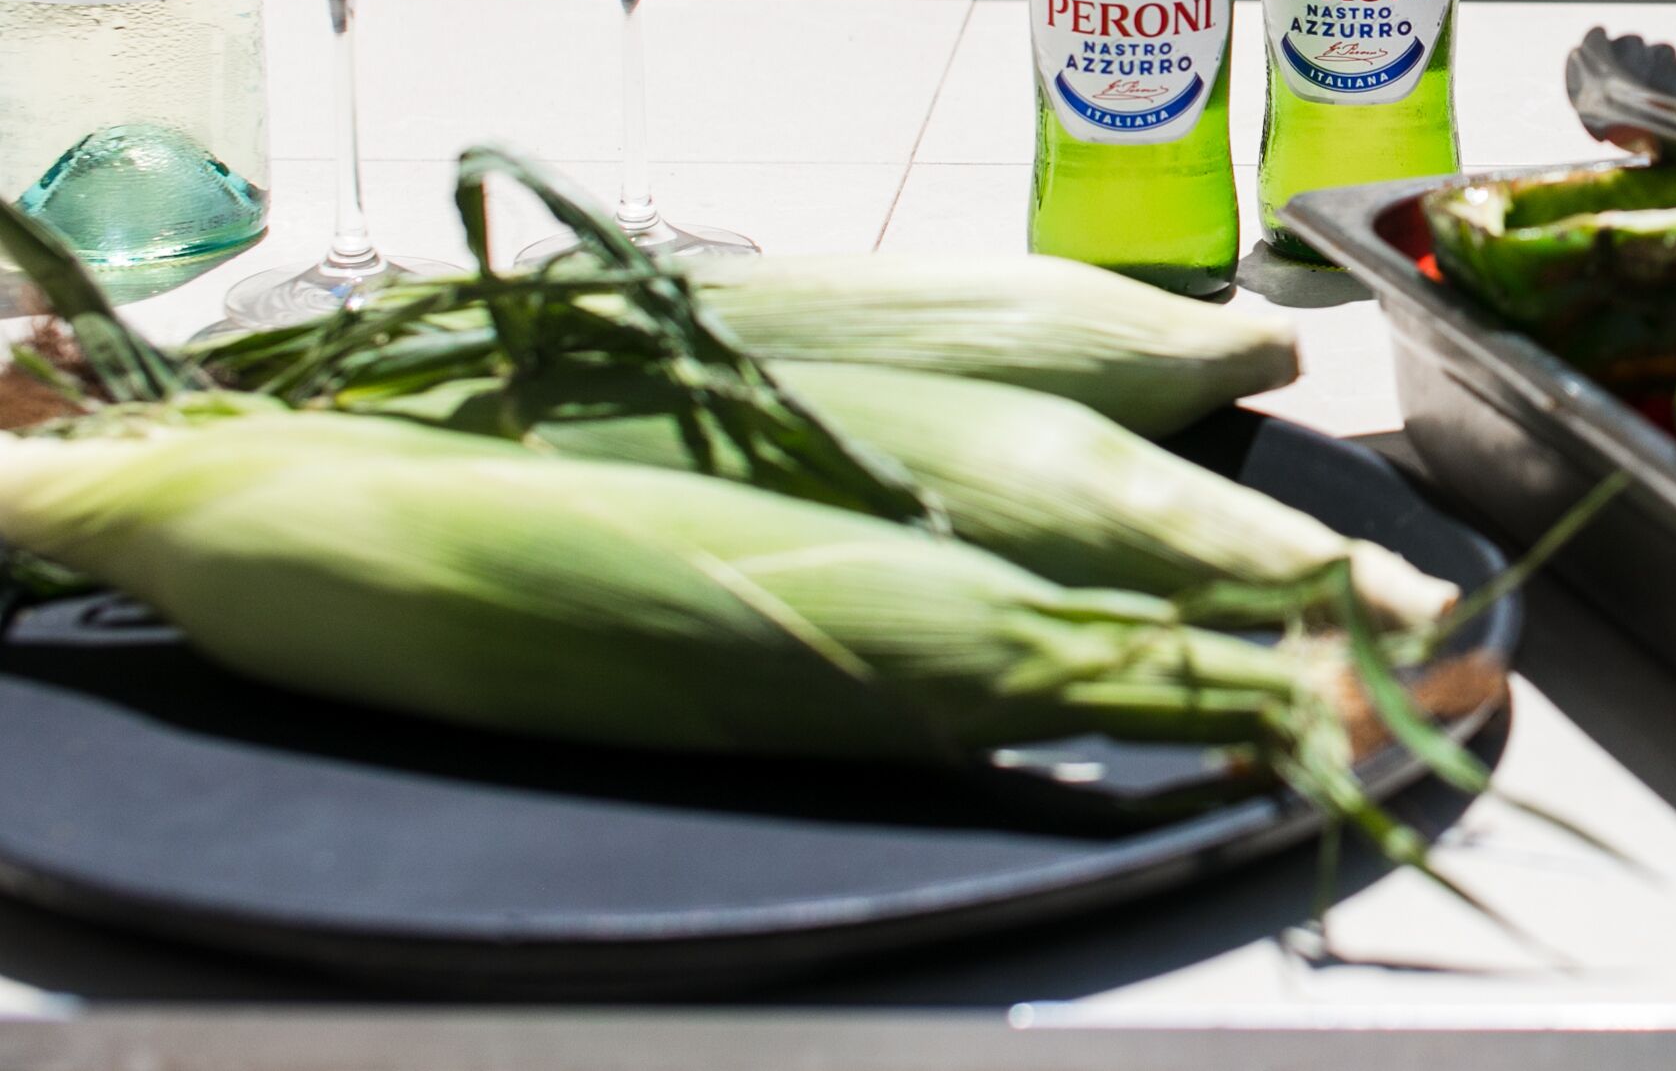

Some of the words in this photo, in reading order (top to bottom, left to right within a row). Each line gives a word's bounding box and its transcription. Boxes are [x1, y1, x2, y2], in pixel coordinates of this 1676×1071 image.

[1306, 3, 1392, 20] NASTRO
[1290, 17, 1413, 39] AZZURRO
[1083, 40, 1173, 56] NASTRO
[1066, 54, 1193, 76] AZZURRO
[1309, 68, 1389, 88] ITALIANA
[1085, 107, 1170, 126] ITALIANA
